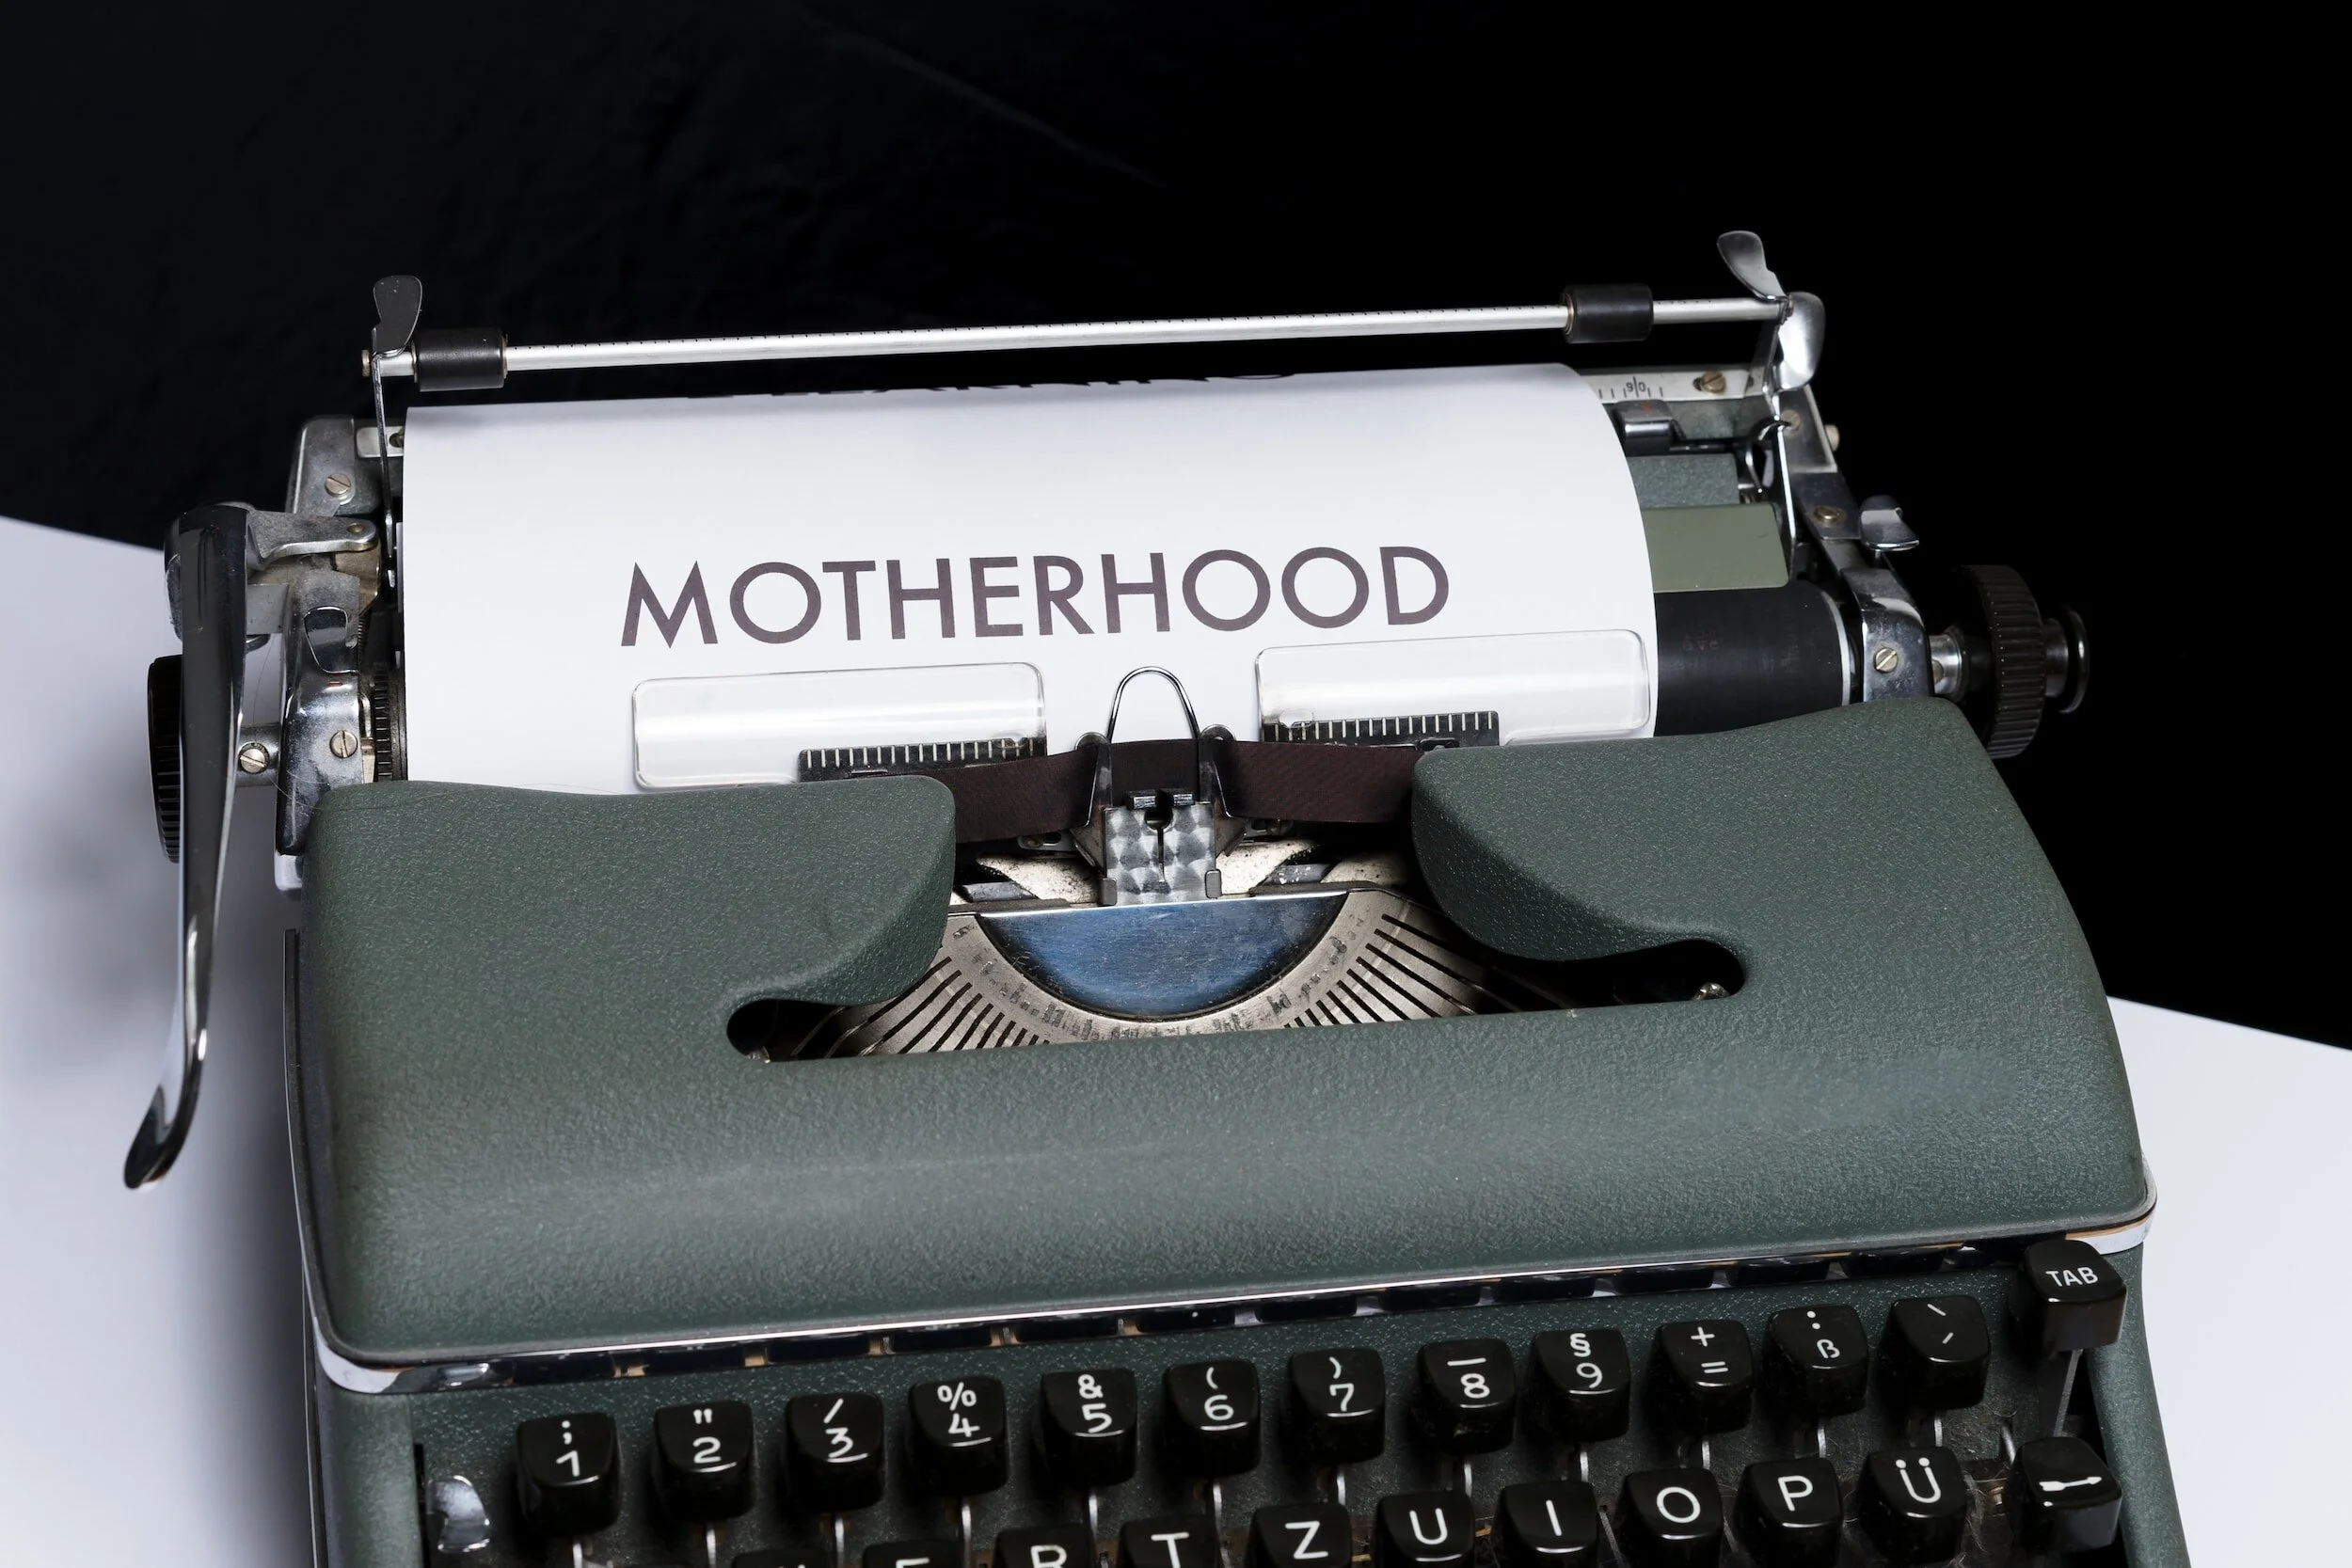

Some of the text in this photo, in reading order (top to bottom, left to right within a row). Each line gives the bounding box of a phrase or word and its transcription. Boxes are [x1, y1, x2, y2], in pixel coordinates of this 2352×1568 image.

[622, 546, 1449, 647] MOTHERHOOD
[2045, 1266, 2099, 1287] TAB
[1569, 1332, 1592, 1358] §
[1691, 1326, 1715, 1347] +
[1077, 1373, 1104, 1400] &
[1460, 1372, 1490, 1399] 8
[1576, 1362, 1603, 1388] 9
[937, 1382, 977, 1411] %
[1203, 1394, 1234, 1421] 6
[1328, 1382, 1356, 1413] 7
[947, 1412, 981, 1439] 4
[1081, 1402, 1114, 1434] 5
[692, 1436, 722, 1464] 2
[824, 1426, 855, 1458] 3
[556, 1450, 580, 1477] 1
[1777, 1475, 1814, 1512] P
[1895, 1457, 1942, 1504] Ü
[1656, 1486, 1701, 1524] O
[1284, 1520, 1328, 1560] Z
[1408, 1508, 1448, 1545] U
[1151, 1531, 1190, 1568] T
